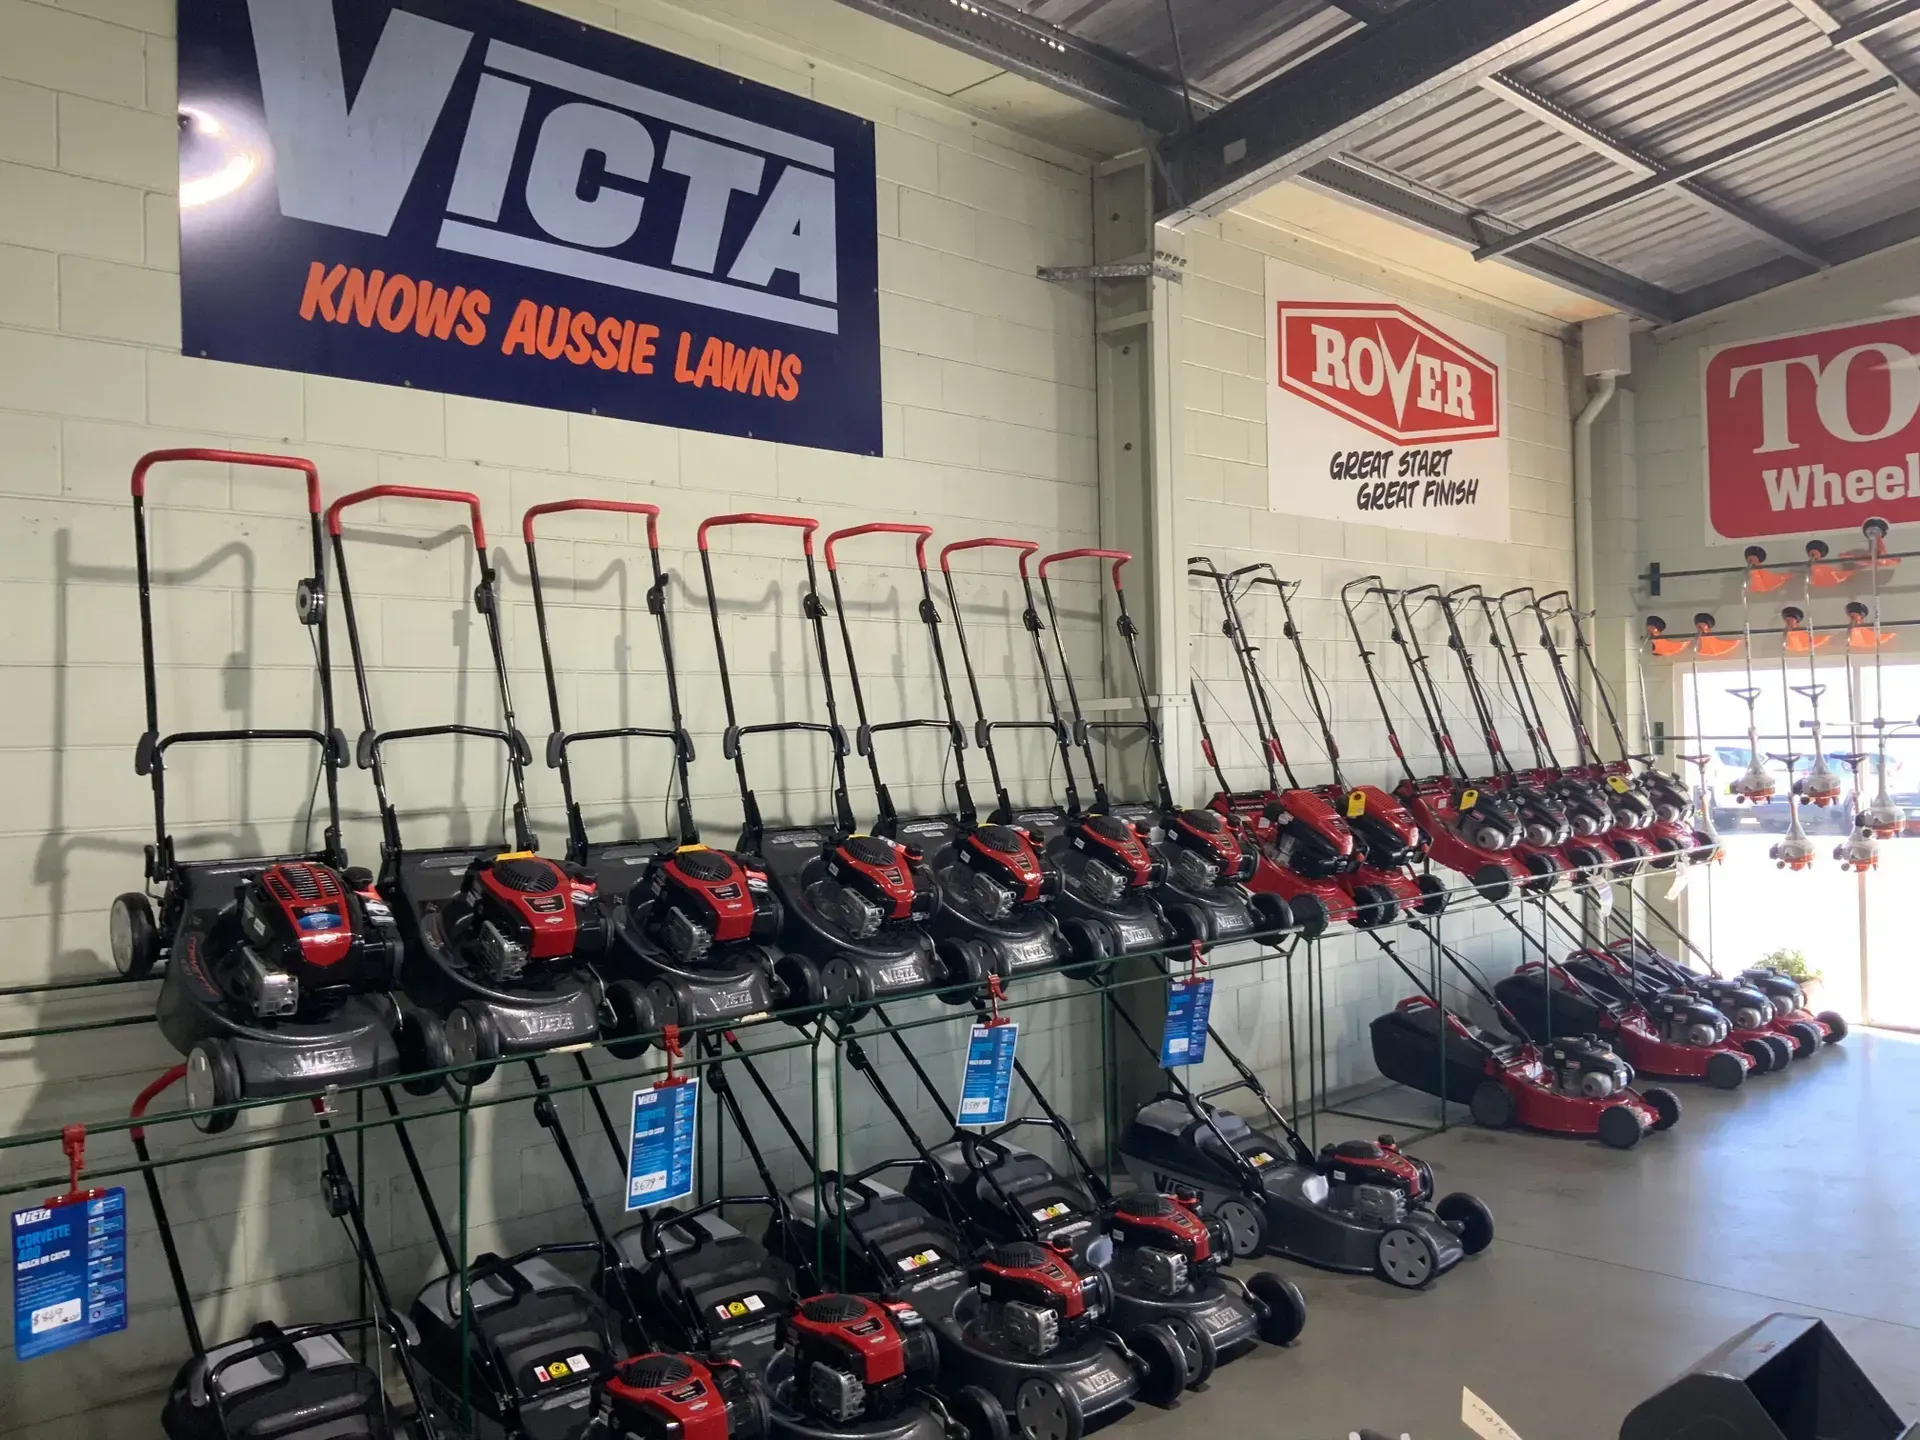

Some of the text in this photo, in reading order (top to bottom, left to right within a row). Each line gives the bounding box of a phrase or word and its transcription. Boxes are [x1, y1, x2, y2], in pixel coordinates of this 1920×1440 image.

[247, 0, 838, 303] VICTA
[299, 261, 802, 402] KNOWS AUSSIE LAWNS
[1311, 321, 1475, 429] ROVER
[1729, 342, 1920, 454] TO
[1330, 449, 1453, 480] GREAT START
[1357, 478, 1479, 511] GREAT FINISH
[15, 1208, 51, 1226] VICTA
[16, 1224, 71, 1249] CORVETTE
